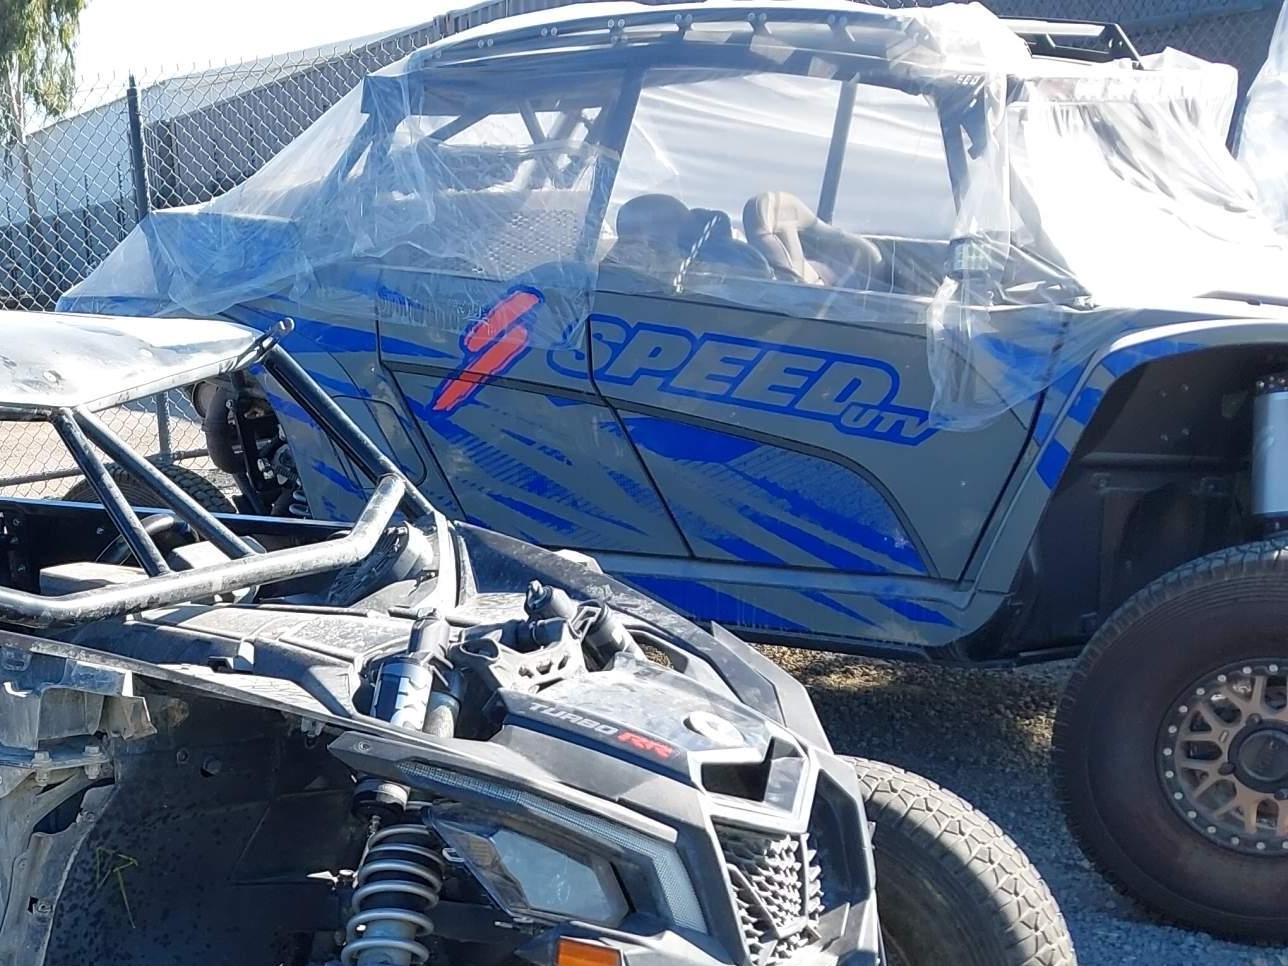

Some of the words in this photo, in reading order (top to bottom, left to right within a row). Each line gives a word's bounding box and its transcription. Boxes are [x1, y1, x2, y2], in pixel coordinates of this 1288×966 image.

[548, 315, 898, 422] SPEED
[840, 402, 932, 440] UTV
[528, 701, 619, 736] TURBO
